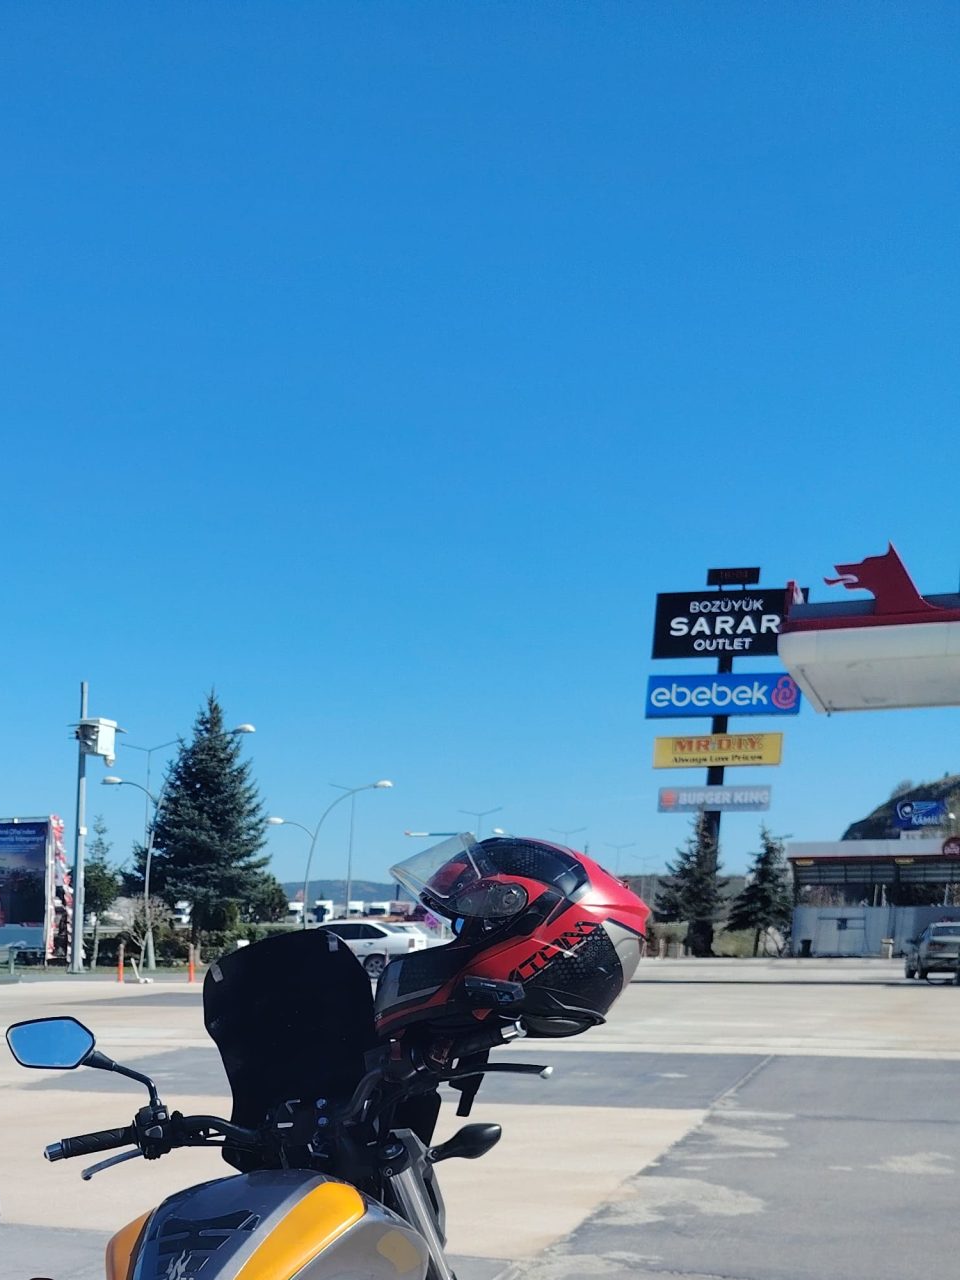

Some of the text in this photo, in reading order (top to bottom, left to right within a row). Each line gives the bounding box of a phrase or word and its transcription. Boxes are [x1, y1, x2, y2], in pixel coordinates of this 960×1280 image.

[690, 597, 764, 613] BOZÜYÜK
[669, 614, 781, 637] SARAR
[693, 637, 753, 651] OUTLET
[650, 681, 769, 708] ebebek
[678, 790, 769, 806] BURGER KING
